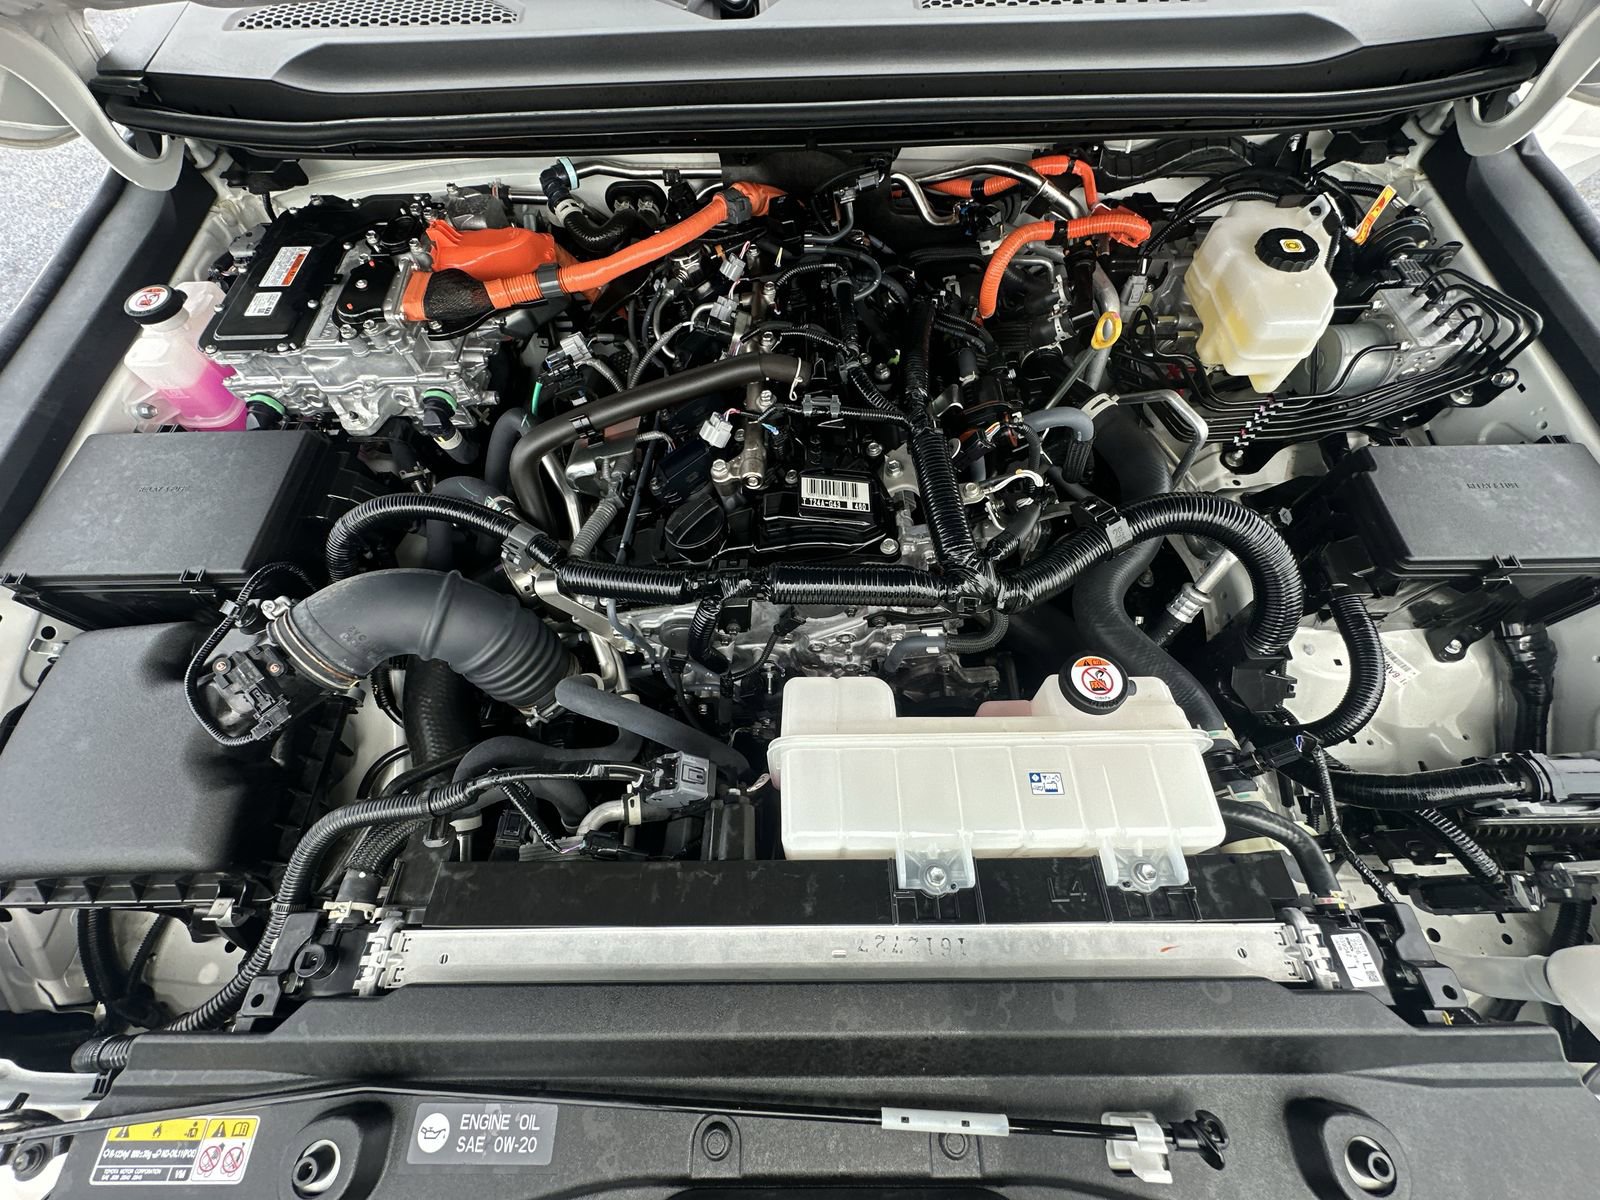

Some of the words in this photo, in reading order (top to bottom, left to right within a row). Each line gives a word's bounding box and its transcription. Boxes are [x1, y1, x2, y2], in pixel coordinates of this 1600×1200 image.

[459, 1113, 511, 1130] ENGINE
[519, 1114, 541, 1131] OIL
[456, 1135, 486, 1153] SAE
[493, 1135, 538, 1153] 0W-20
